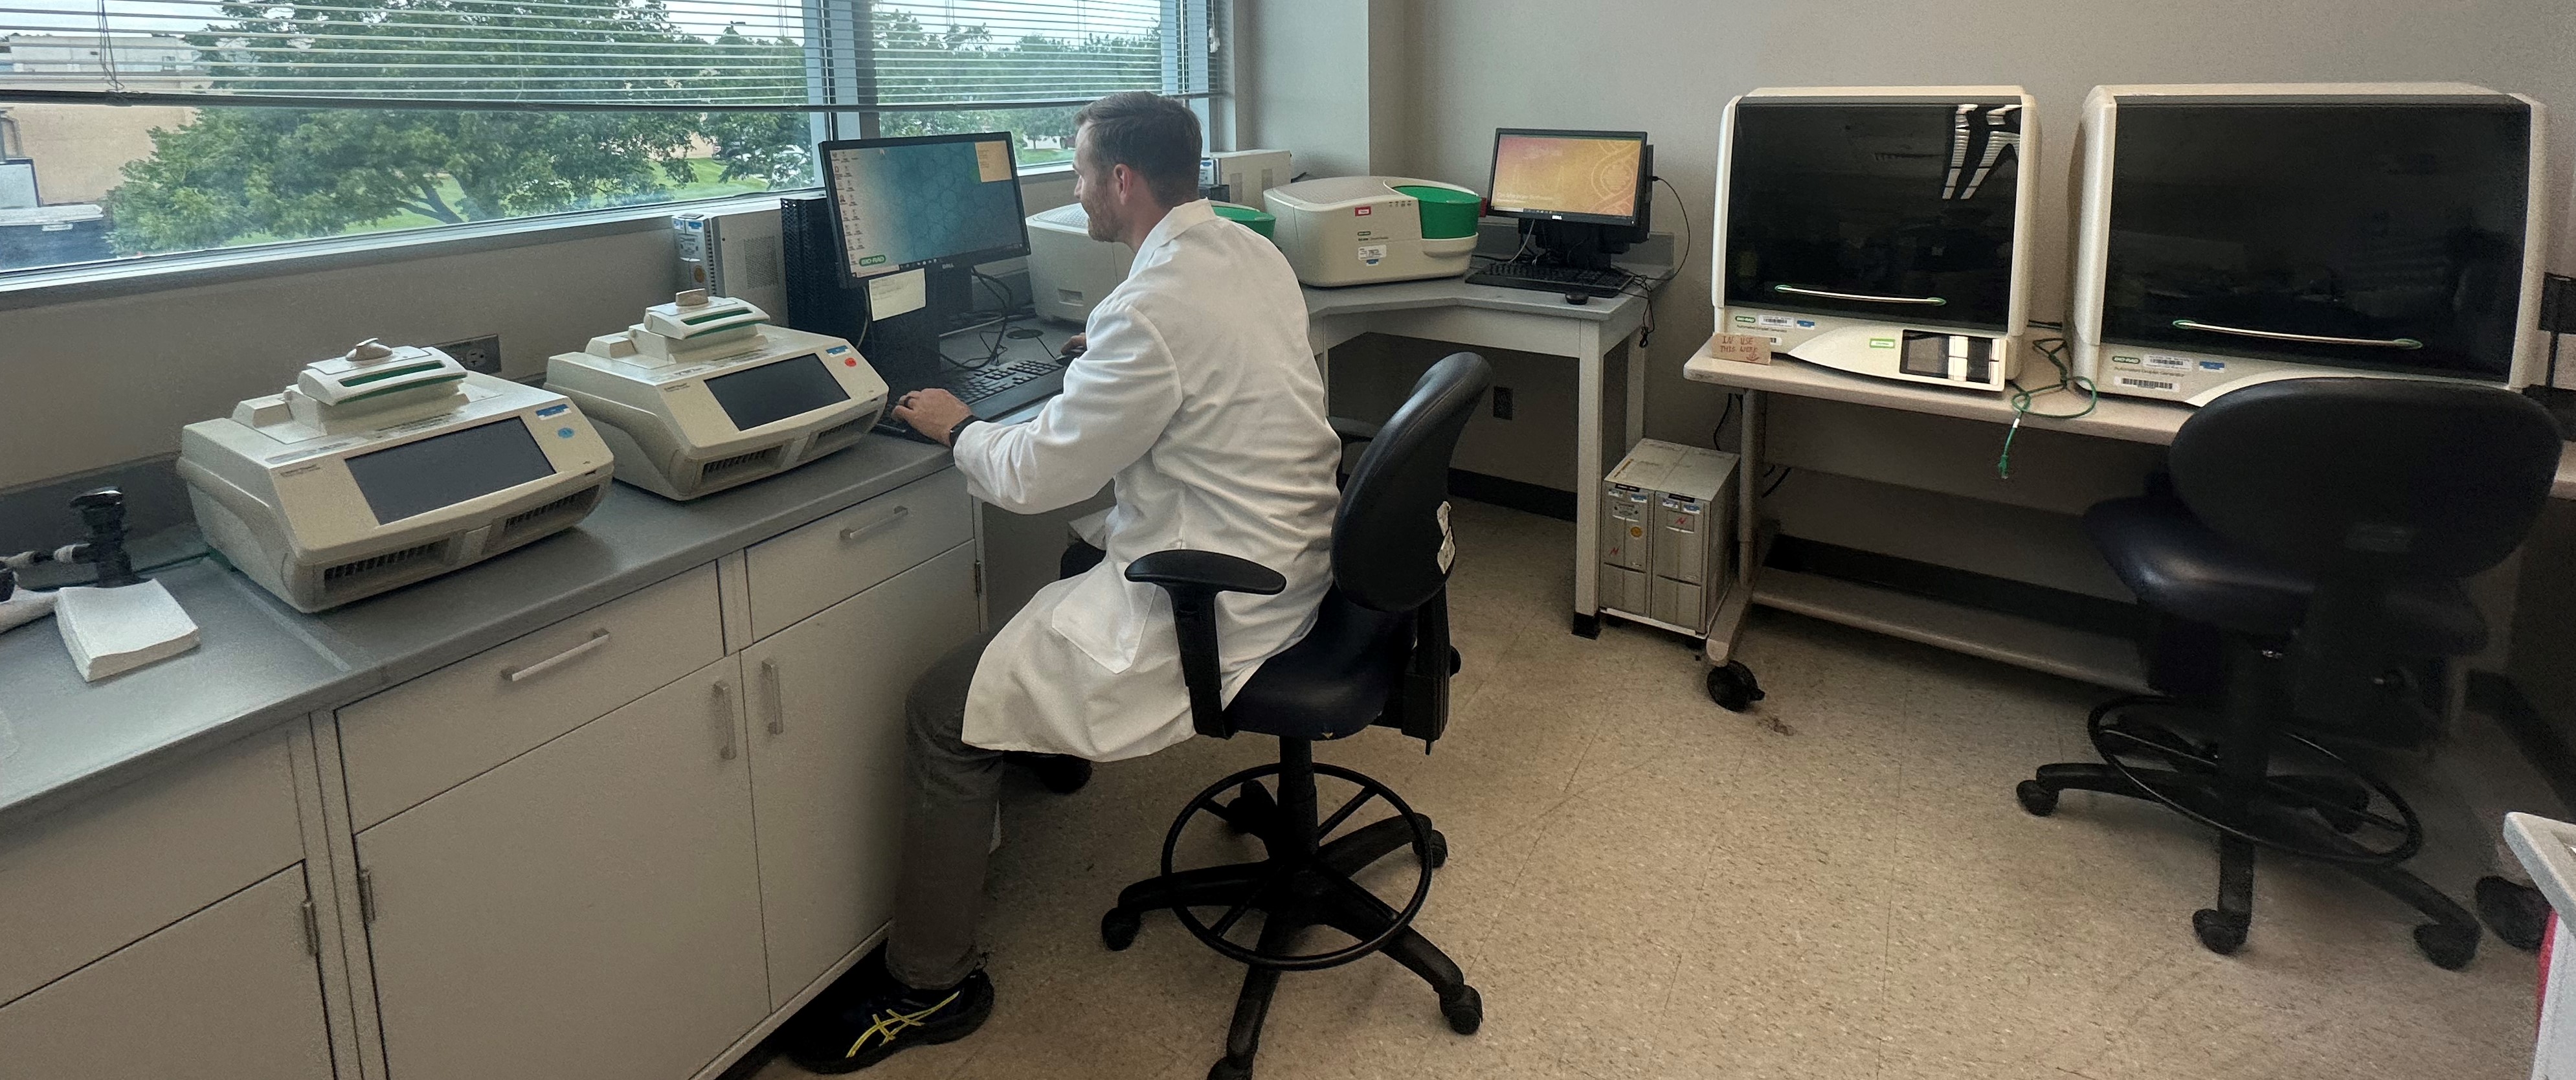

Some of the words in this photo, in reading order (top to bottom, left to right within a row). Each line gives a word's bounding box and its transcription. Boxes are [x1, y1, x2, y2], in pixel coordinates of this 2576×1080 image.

[860, 256, 885, 265] BIO-RAD
[1722, 335, 1734, 344] IN
[1739, 337, 1754, 345] USE
